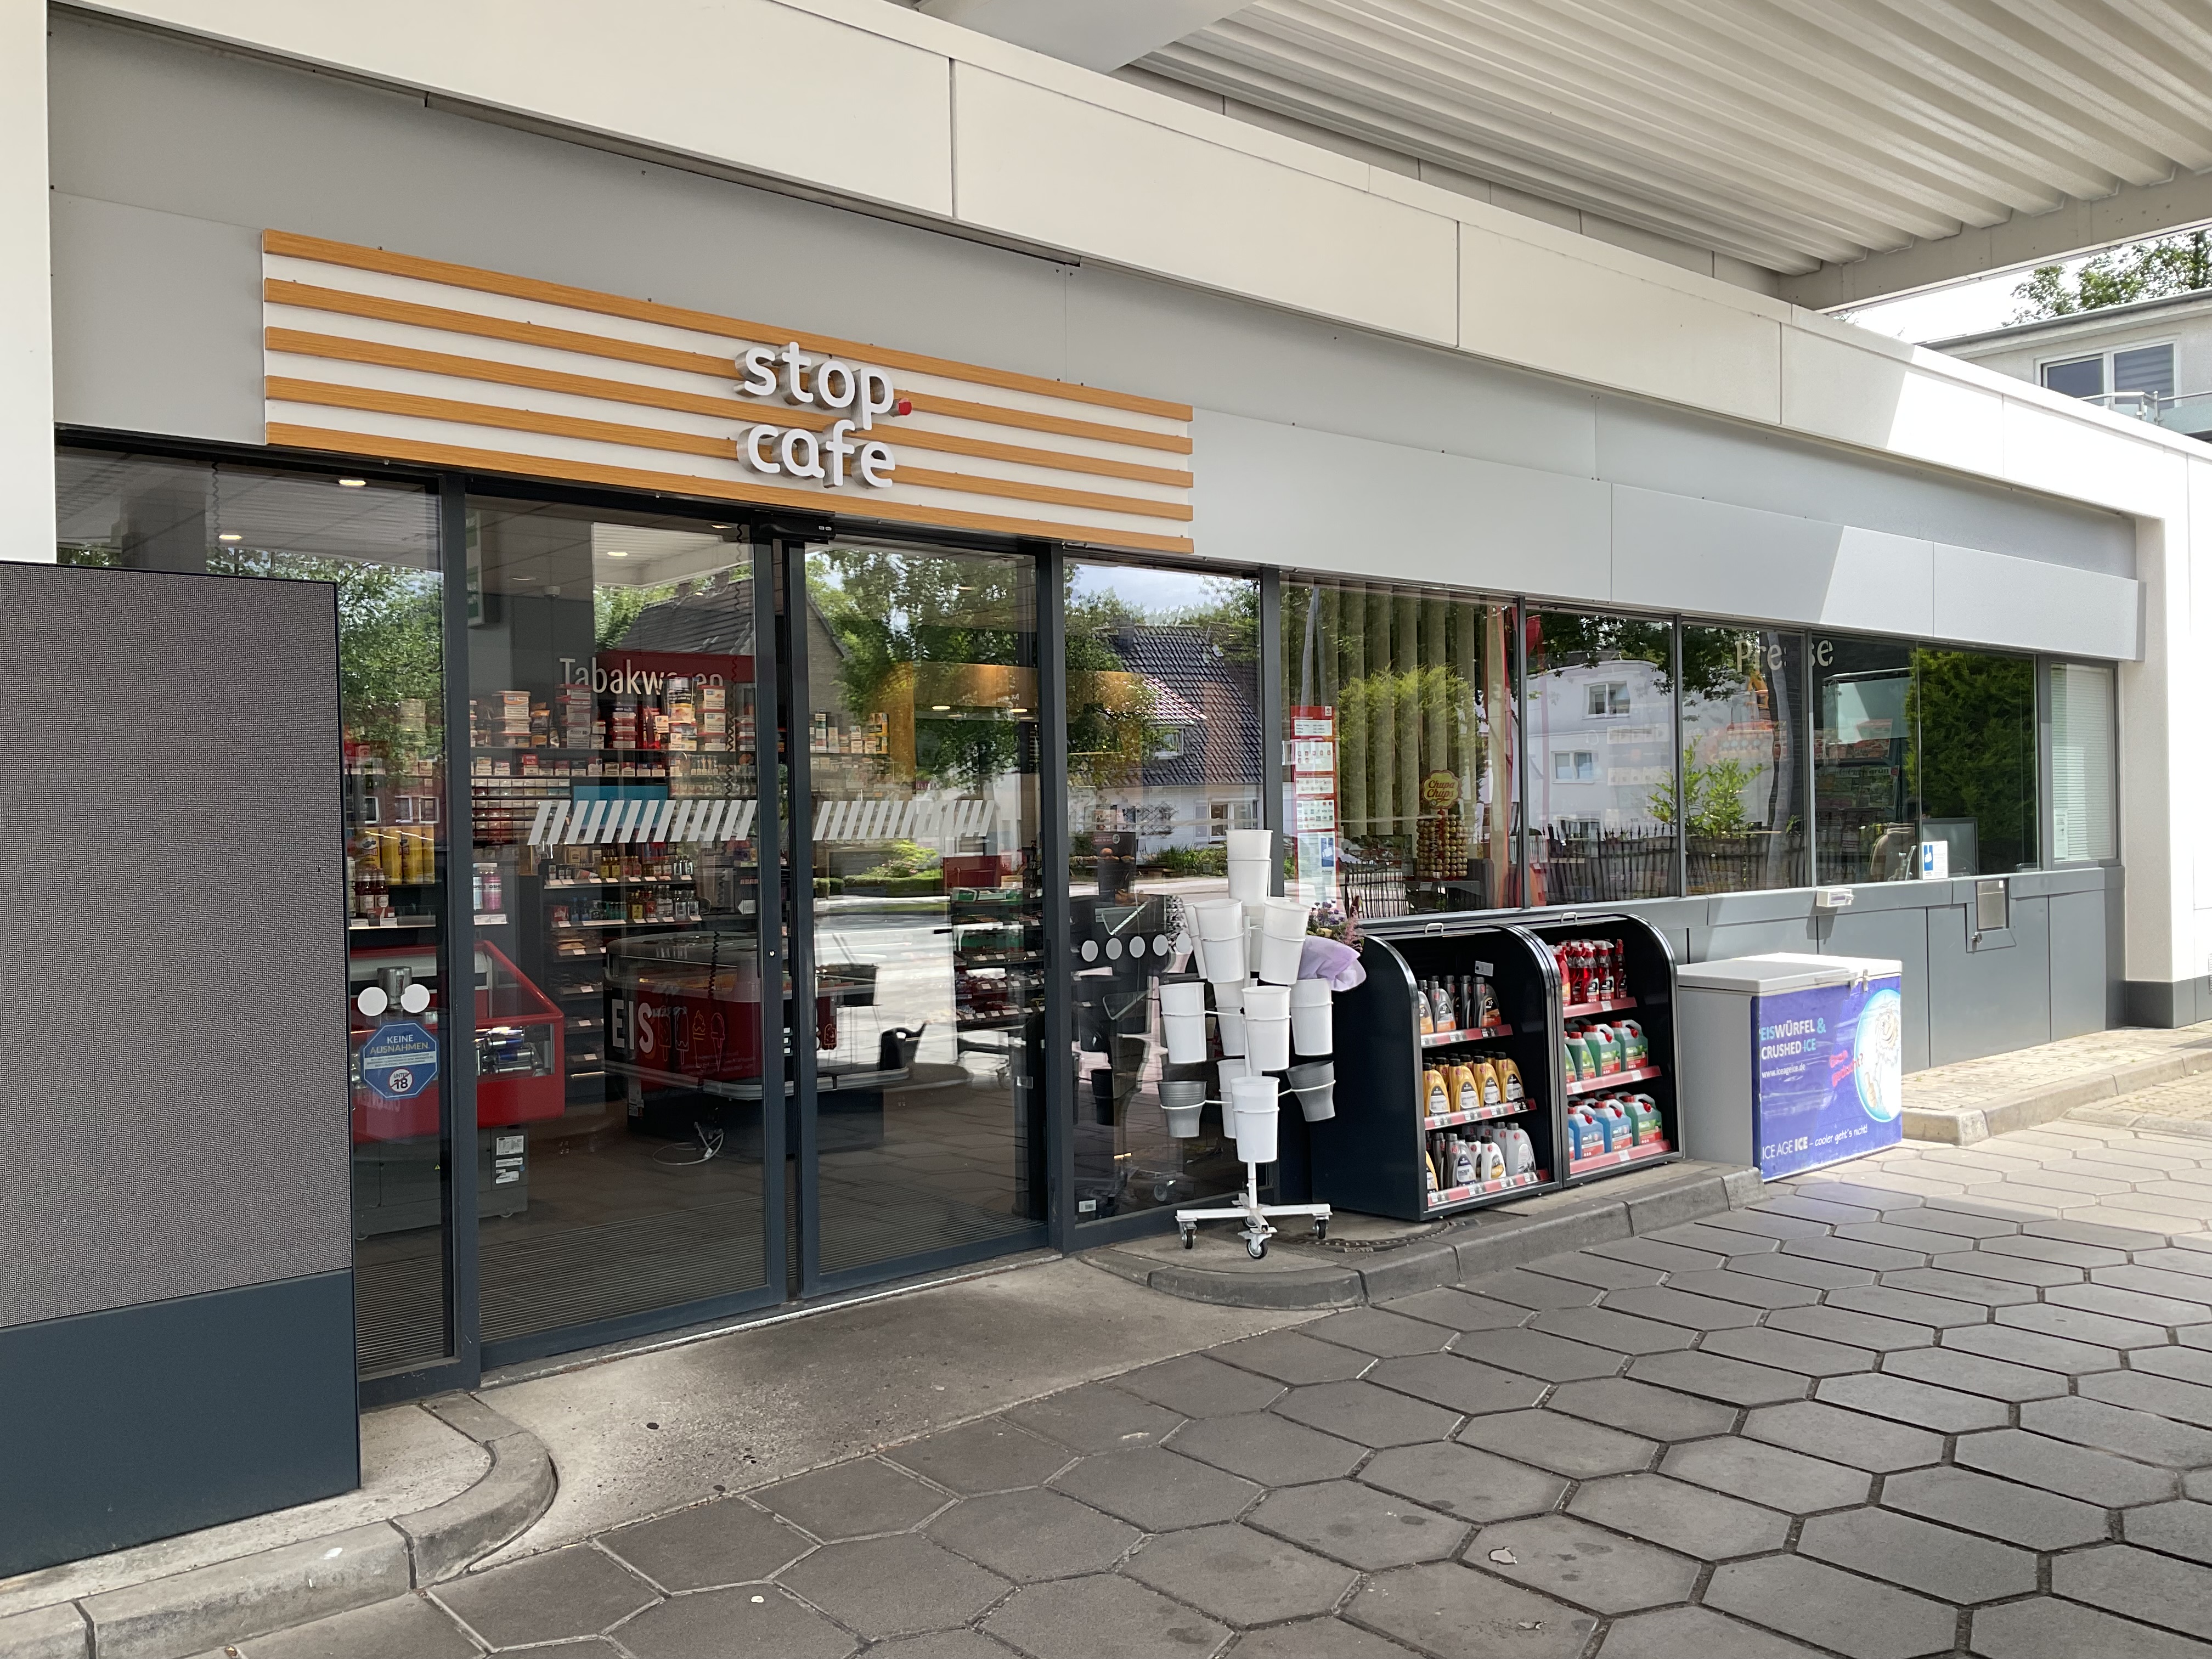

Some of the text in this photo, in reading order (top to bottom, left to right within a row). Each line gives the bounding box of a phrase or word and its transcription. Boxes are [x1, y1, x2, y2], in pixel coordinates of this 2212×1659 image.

[737, 419, 895, 488] cafe
[1736, 640, 1833, 673] Pree
[559, 657, 723, 695] Tabakwen
[1427, 789, 1453, 799] Chups
[1429, 780, 1455, 789] Chupa
[612, 998, 654, 1053] EIS
[1760, 1017, 1826, 1041] EISWÜRFEL &
[387, 1034, 414, 1044] KEINE
[1761, 1038, 1816, 1060] CRUSHED ICE
[1762, 1062, 1806, 1079] www.iceageice.de
[393, 1078, 409, 1090] 18
[1762, 1144, 1775, 1160] ICE
[1776, 1140, 1793, 1157] AGE
[1795, 1136, 1808, 1152] ICE
[1815, 1134, 1833, 1147] cooler
